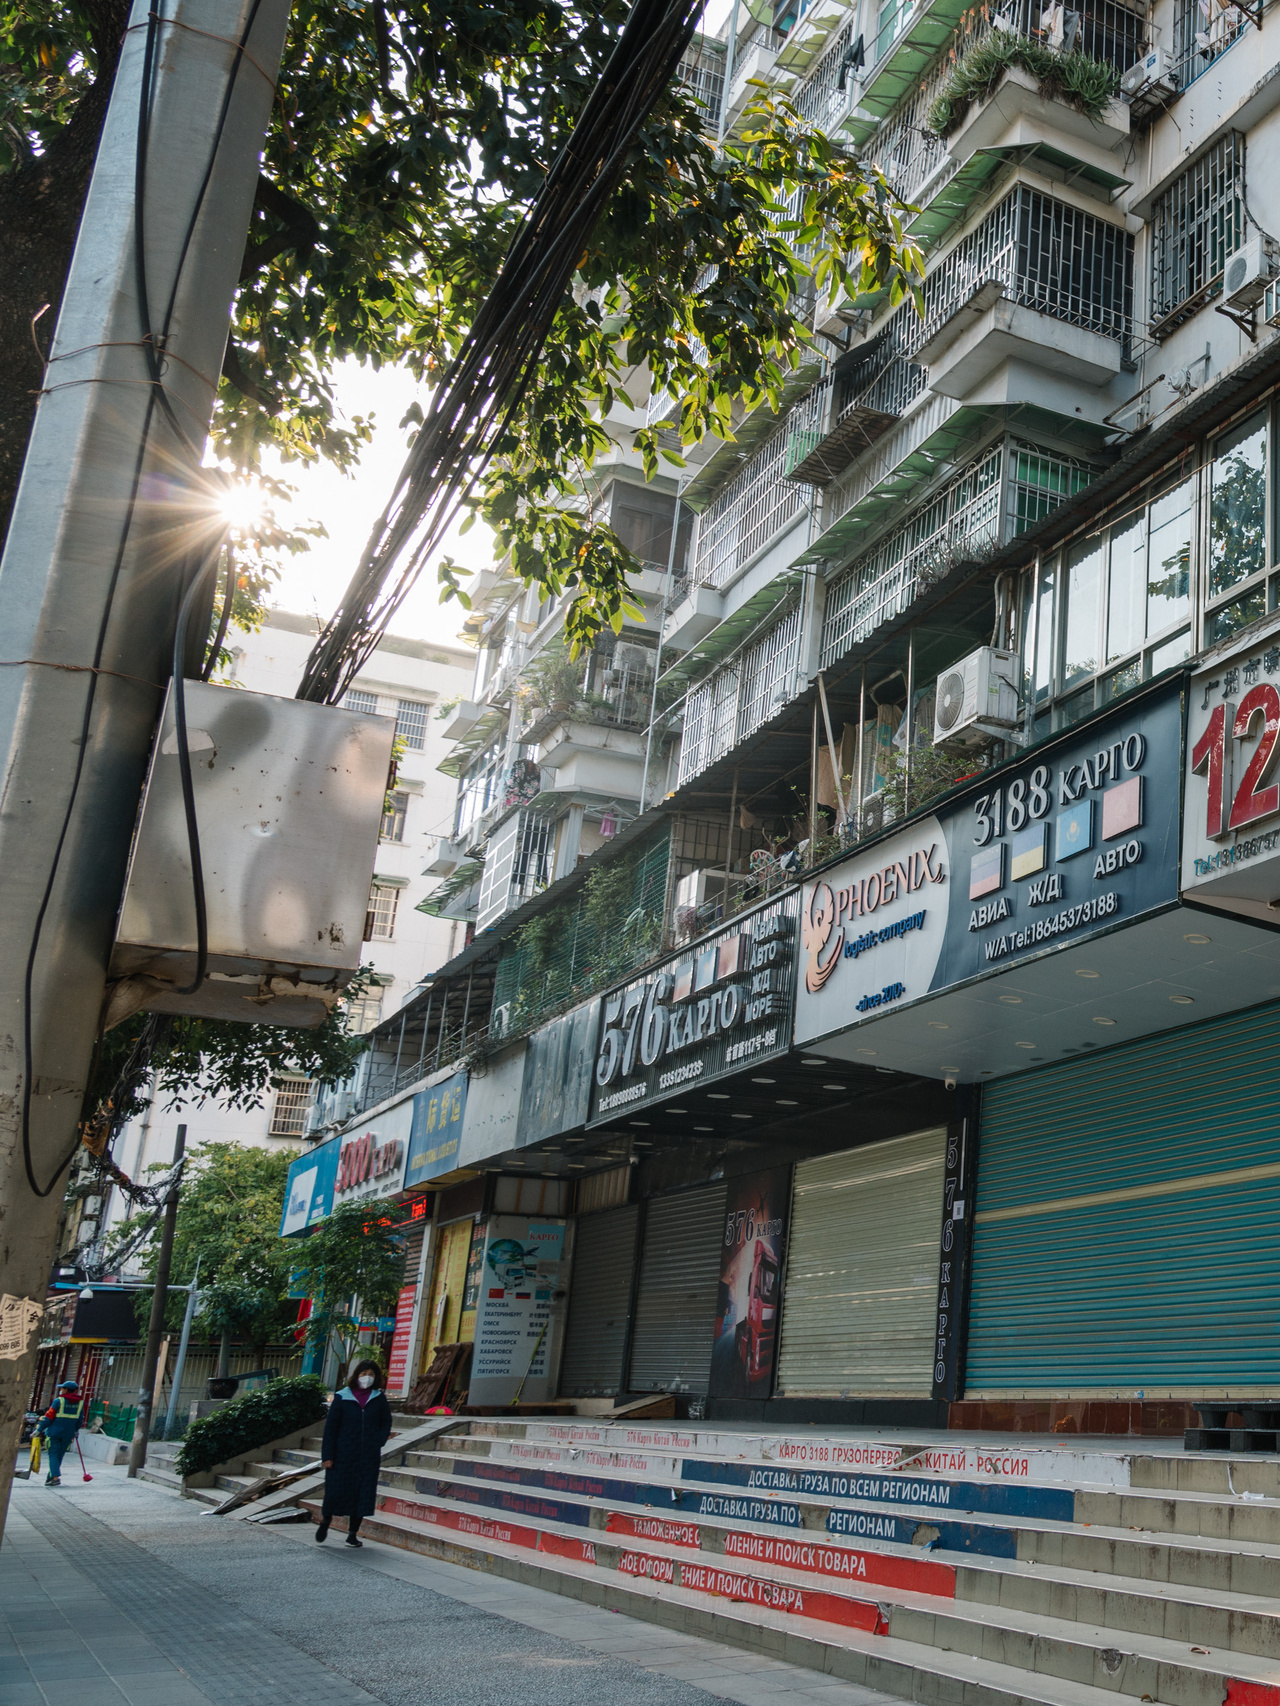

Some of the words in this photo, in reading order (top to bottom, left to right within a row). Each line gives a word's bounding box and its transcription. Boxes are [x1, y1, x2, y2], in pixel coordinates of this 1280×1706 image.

[972, 765, 1051, 847] 3188
[1059, 732, 1146, 806] КАРГО
[835, 843, 946, 926] PHOENIX
[967, 896, 1012, 933] АВИА
[1027, 872, 1063, 907] Ж/Д
[1092, 839, 1143, 880] АВТО
[751, 914, 782, 944] АВИА
[844, 930, 878, 959] logistic
[877, 909, 927, 943] company
[984, 929, 1009, 961] W/A
[749, 940, 780, 971] АВТО
[744, 992, 774, 1024] МОРЕ
[596, 973, 674, 1086] 576
[665, 983, 746, 1054] КАРГО
[529, 1232, 559, 1242] КАРГО
[725, 1208, 755, 1247] 576
[756, 1218, 783, 1238] КАРГО
[636, 1431, 651, 1446] Карго
[653, 1433, 670, 1446] Китай
[671, 1435, 690, 1448] Россия
[595, 1452, 610, 1468] Карго
[629, 1456, 647, 1470] Россия
[779, 1443, 807, 1460] КАРГО
[809, 1447, 829, 1462] 3188
[925, 1448, 966, 1471] КИТАЙ
[748, 1470, 798, 1489] ДОСТАВКА
[799, 1474, 830, 1493] ГРУЗА
[832, 1478, 848, 1494] ПО
[850, 1479, 880, 1498] ВСЕМ
[882, 1481, 950, 1504] РЕГИОНАМ
[466, 1517, 479, 1534] Карго
[495, 1525, 511, 1540] Россия
[700, 1496, 748, 1518] ДОСТАВКА
[749, 1499, 778, 1521] ГРУЗА
[780, 1504, 796, 1524] ПО
[829, 1511, 896, 1538] РЕГИОНАМ
[765, 1542, 773, 1559] И
[775, 1544, 815, 1566] ПОИСК
[818, 1550, 867, 1576] ТОВАРА
[707, 1570, 715, 1588] И
[717, 1573, 755, 1600] ПОИСК
[757, 1581, 804, 1611] ТОВАРА
